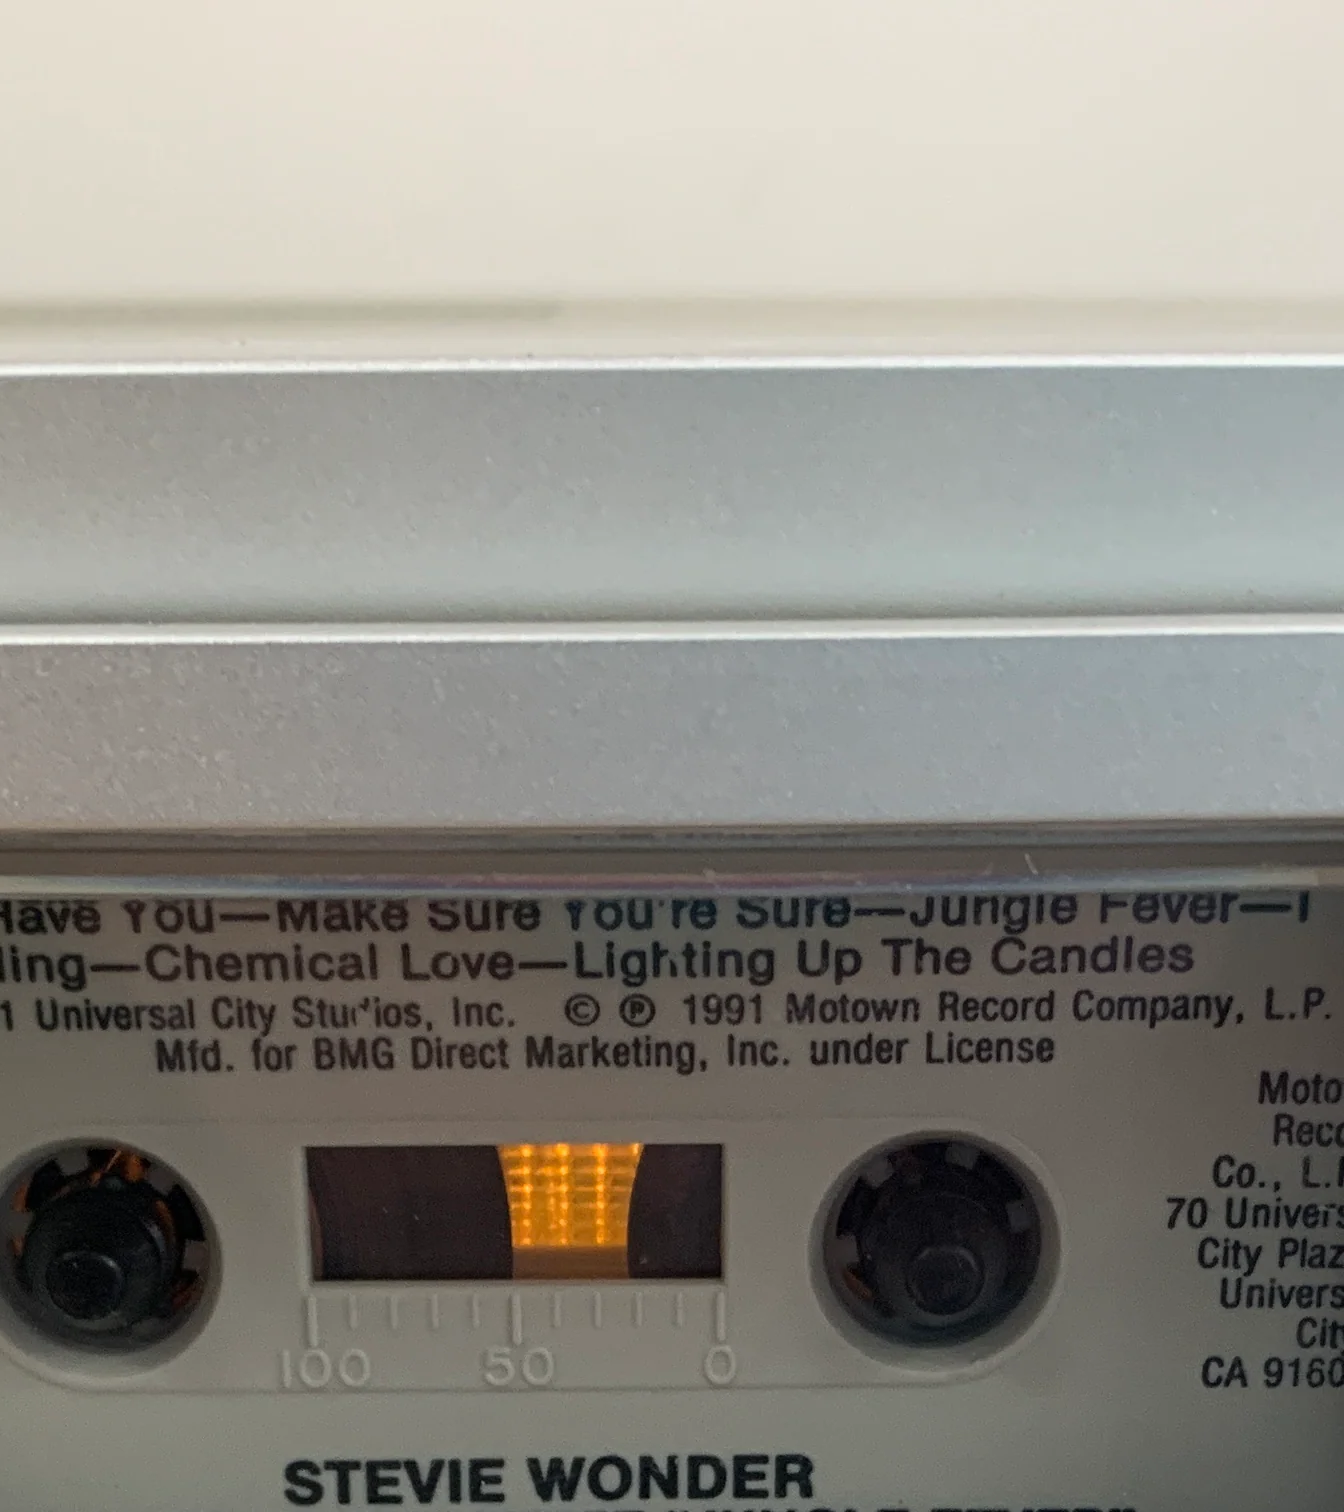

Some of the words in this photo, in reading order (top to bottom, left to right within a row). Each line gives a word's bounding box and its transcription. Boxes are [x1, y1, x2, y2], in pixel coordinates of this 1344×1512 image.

[428, 897, 541, 933] Sure
[797, 939, 862, 985] Up
[881, 937, 971, 976] The
[991, 935, 1194, 975] Candles
[35, 996, 195, 1031] Universal
[211, 995, 276, 1036] City
[452, 996, 515, 1028] Inc.
[683, 993, 762, 1025] 1991
[786, 991, 920, 1024] Motown
[938, 989, 1054, 1022] Record
[1072, 988, 1244, 1028] Company,
[1265, 986, 1332, 1020] L.P.
[155, 1038, 234, 1072] Mfd.
[252, 1037, 297, 1071] for
[313, 1036, 395, 1070] BMG
[411, 1036, 509, 1069] Direct
[525, 1035, 708, 1075] Marketing,
[727, 1034, 790, 1067] Inc.
[810, 1033, 909, 1066] under
[925, 1031, 1055, 1065] License
[1212, 1154, 1280, 1192] Co.,
[1166, 1197, 1208, 1229] 70
[1197, 1237, 1263, 1277] City
[281, 1348, 371, 1389] 100
[482, 1345, 555, 1387] 50
[703, 1344, 737, 1386] 0
[1201, 1356, 1248, 1388] CA
[284, 1457, 506, 1505] STEVIE
[527, 1454, 815, 1501] WONDER
